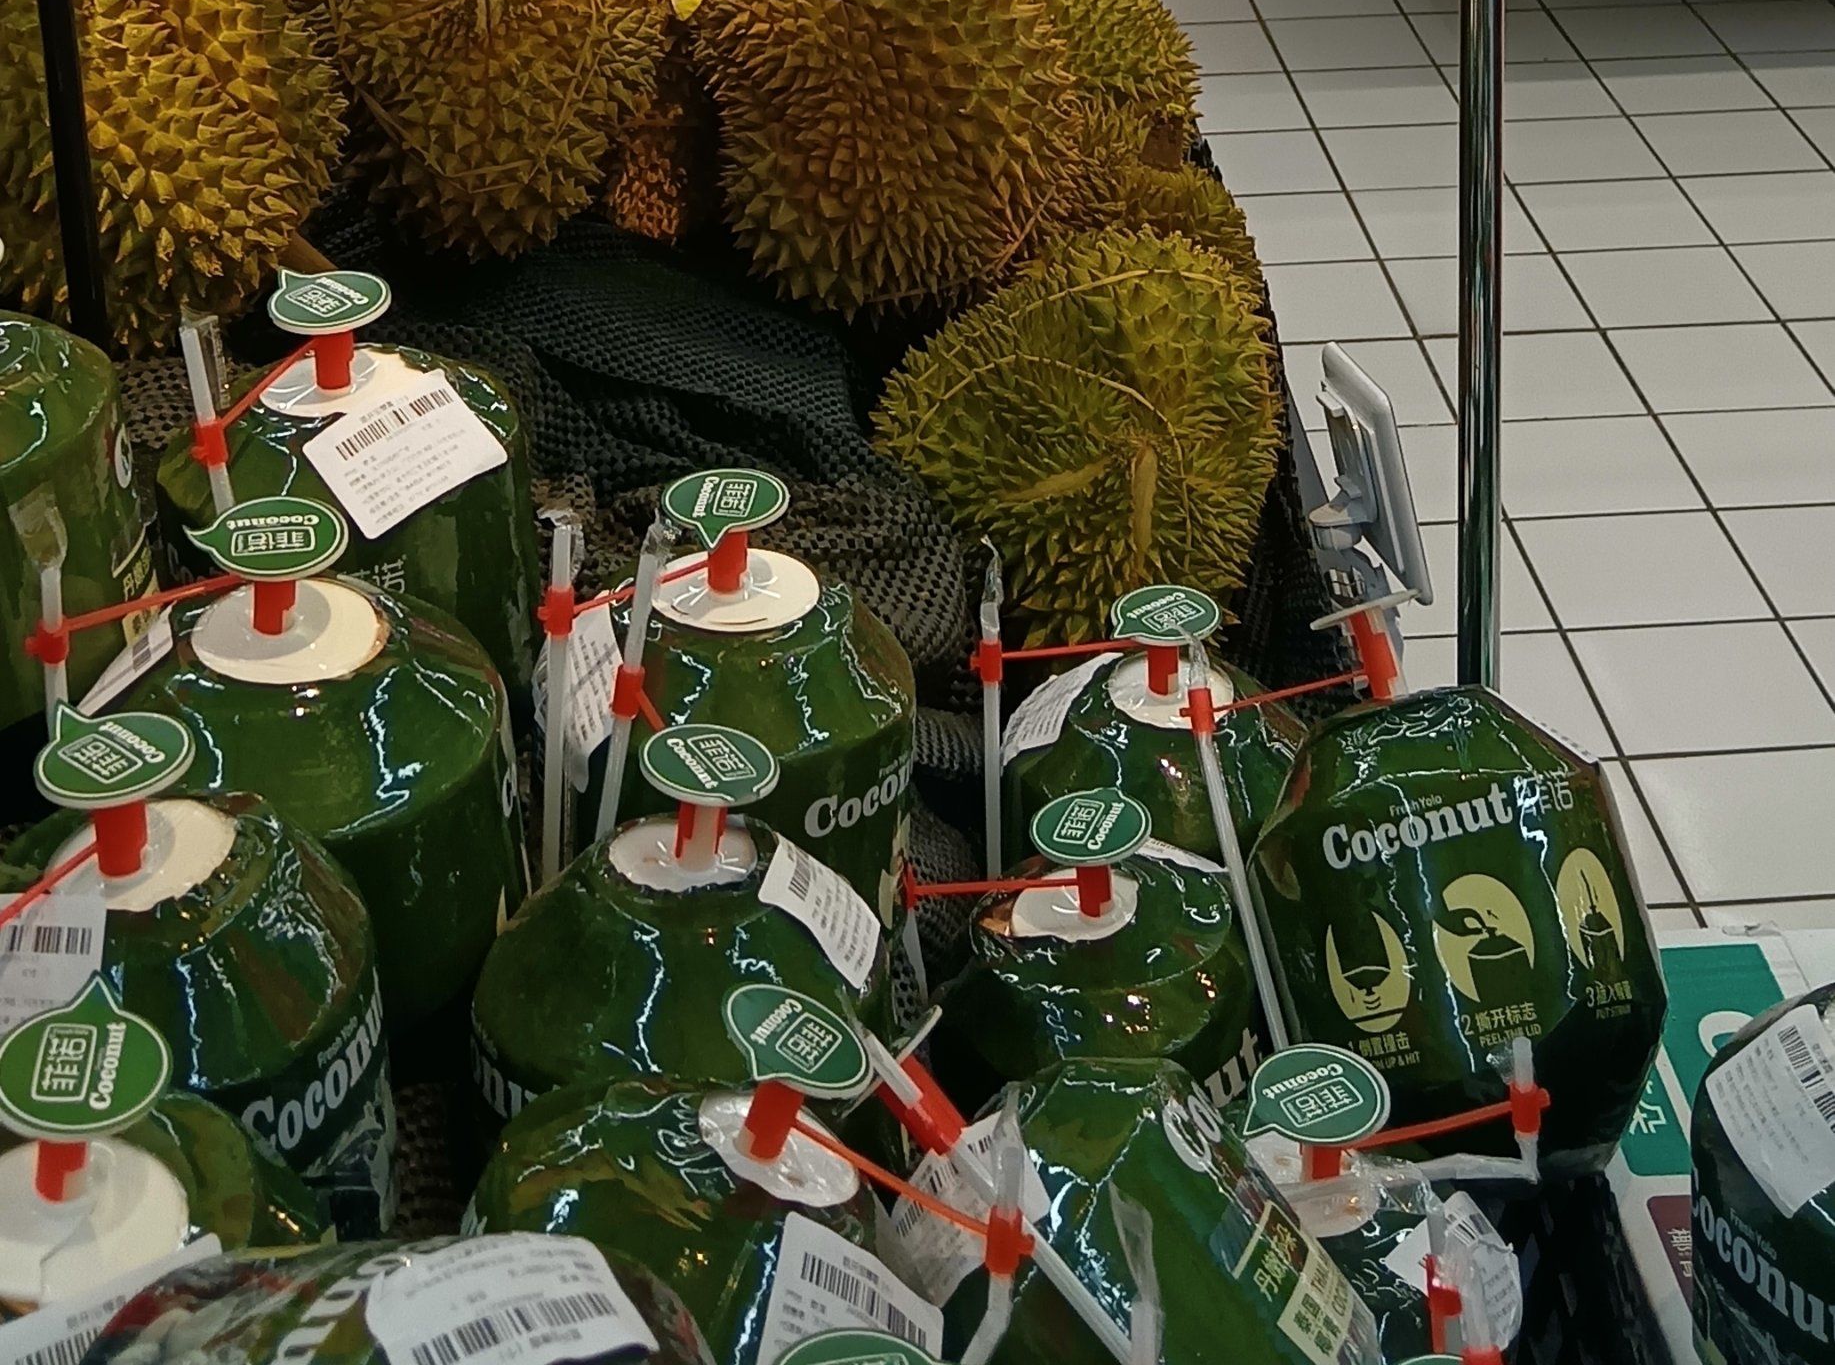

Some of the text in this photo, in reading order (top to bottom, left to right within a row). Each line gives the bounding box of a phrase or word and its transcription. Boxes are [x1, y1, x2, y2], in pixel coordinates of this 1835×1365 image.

[226, 514, 320, 530] Coconut
[1126, 592, 1186, 620] Coconut
[97, 721, 166, 764] Coconut
[666, 737, 720, 790] Coconut
[804, 756, 914, 839] Cocon
[1087, 802, 1126, 850] Coconut
[1322, 782, 1513, 869] Coconut
[750, 998, 802, 1046] Coconut
[1461, 1014, 1475, 1036] 2
[41, 1037, 87, 1092] 菲诺
[89, 1021, 127, 1110] Coconut
[241, 992, 384, 1155] Coconu
[1262, 1062, 1344, 1099] Coconut
[1295, 1083, 1354, 1121] 菲诺
[1692, 1168, 1835, 1344] oconu
